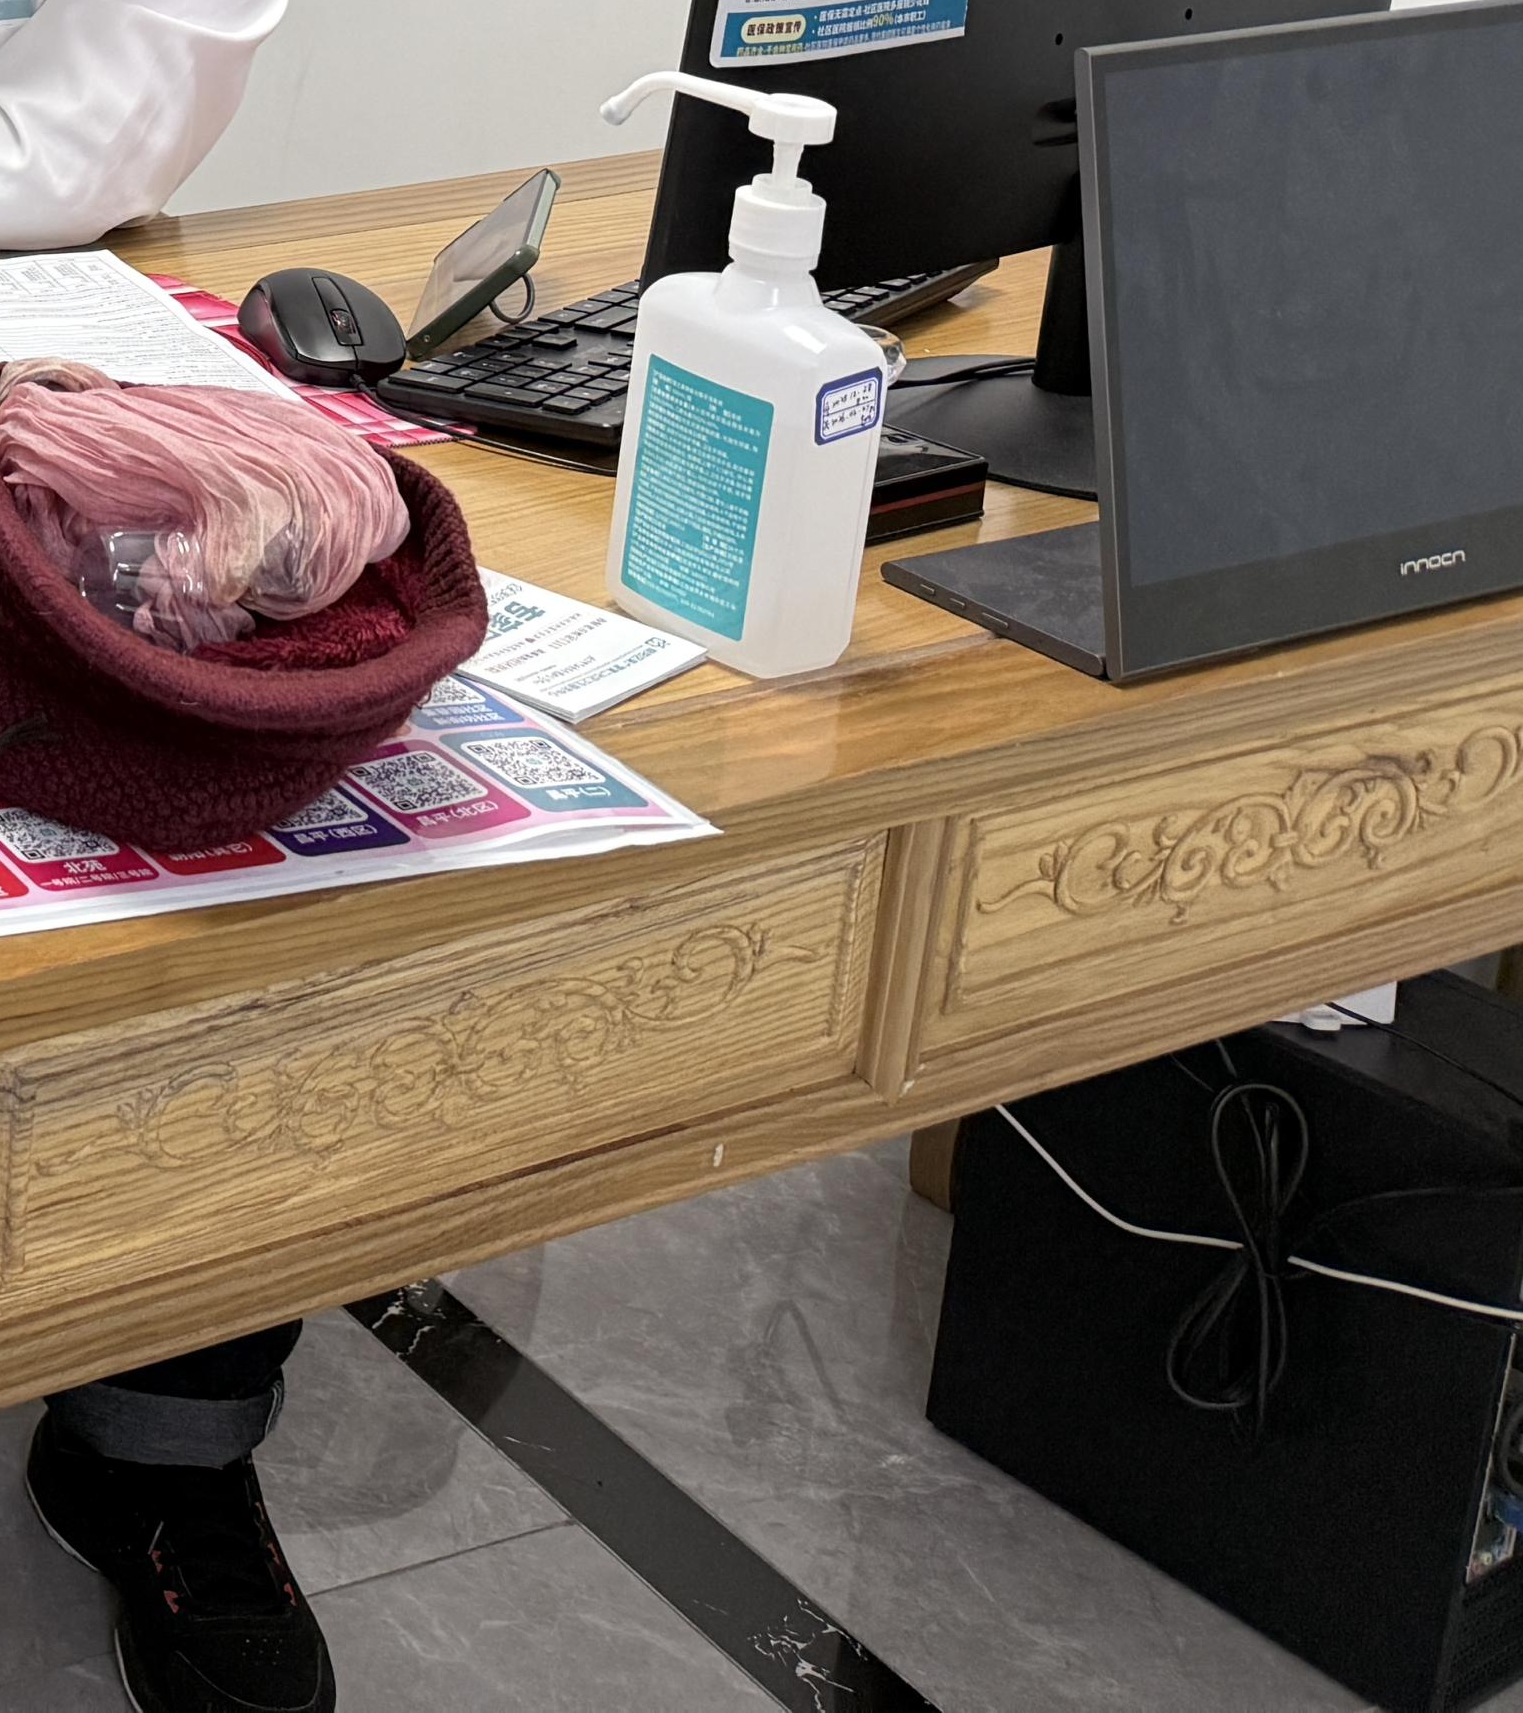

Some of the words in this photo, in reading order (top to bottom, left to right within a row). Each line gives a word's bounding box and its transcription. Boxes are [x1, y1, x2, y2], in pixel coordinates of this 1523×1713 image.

[1400, 549, 1466, 576] innocn
[415, 800, 499, 827] 昌平(北区)
[292, 824, 378, 845] 昌平(西区)
[63, 860, 107, 874] 北苑
